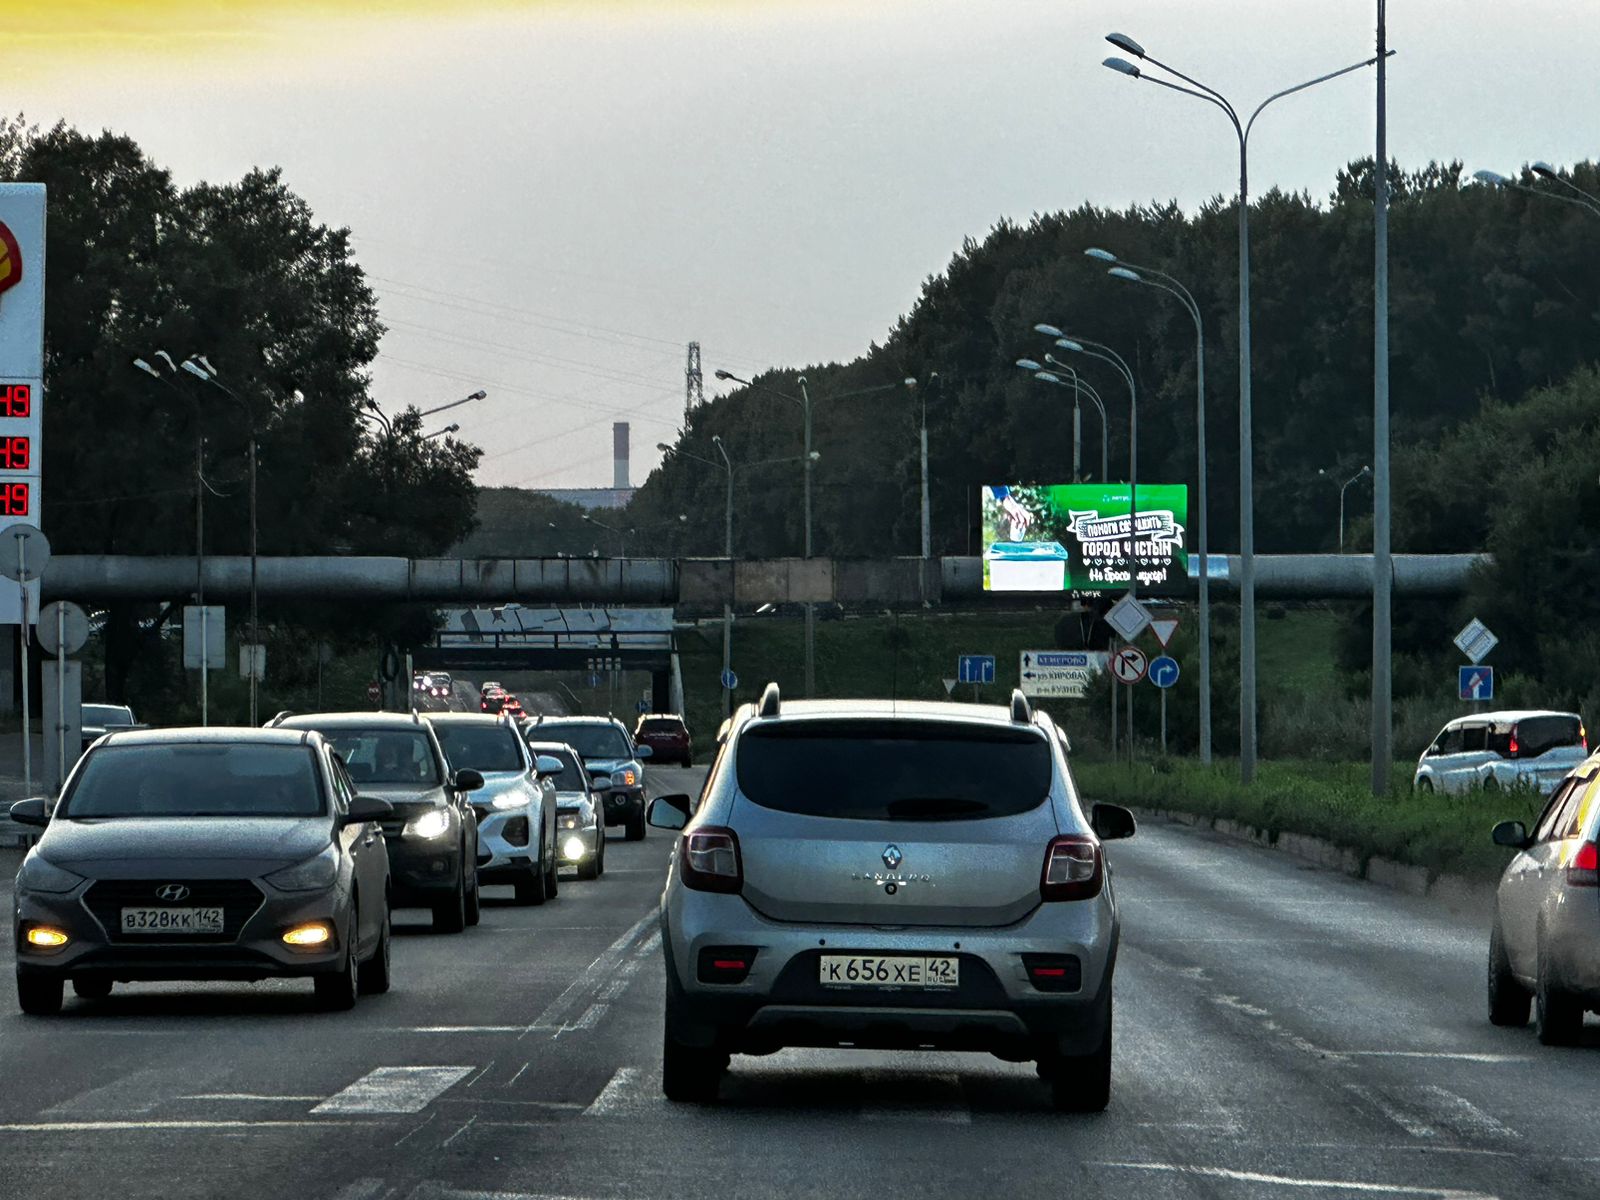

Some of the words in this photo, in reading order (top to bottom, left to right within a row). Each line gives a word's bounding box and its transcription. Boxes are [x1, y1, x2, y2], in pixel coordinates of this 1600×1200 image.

[1087, 521, 1118, 537] ПОМОГИ
[1119, 516, 1162, 532] СОАНИТЬ
[1082, 541, 1121, 558] ГОРОД
[1104, 567, 1131, 583] броса
[829, 959, 921, 982] К656ХЕ
[928, 960, 950, 977] 42
